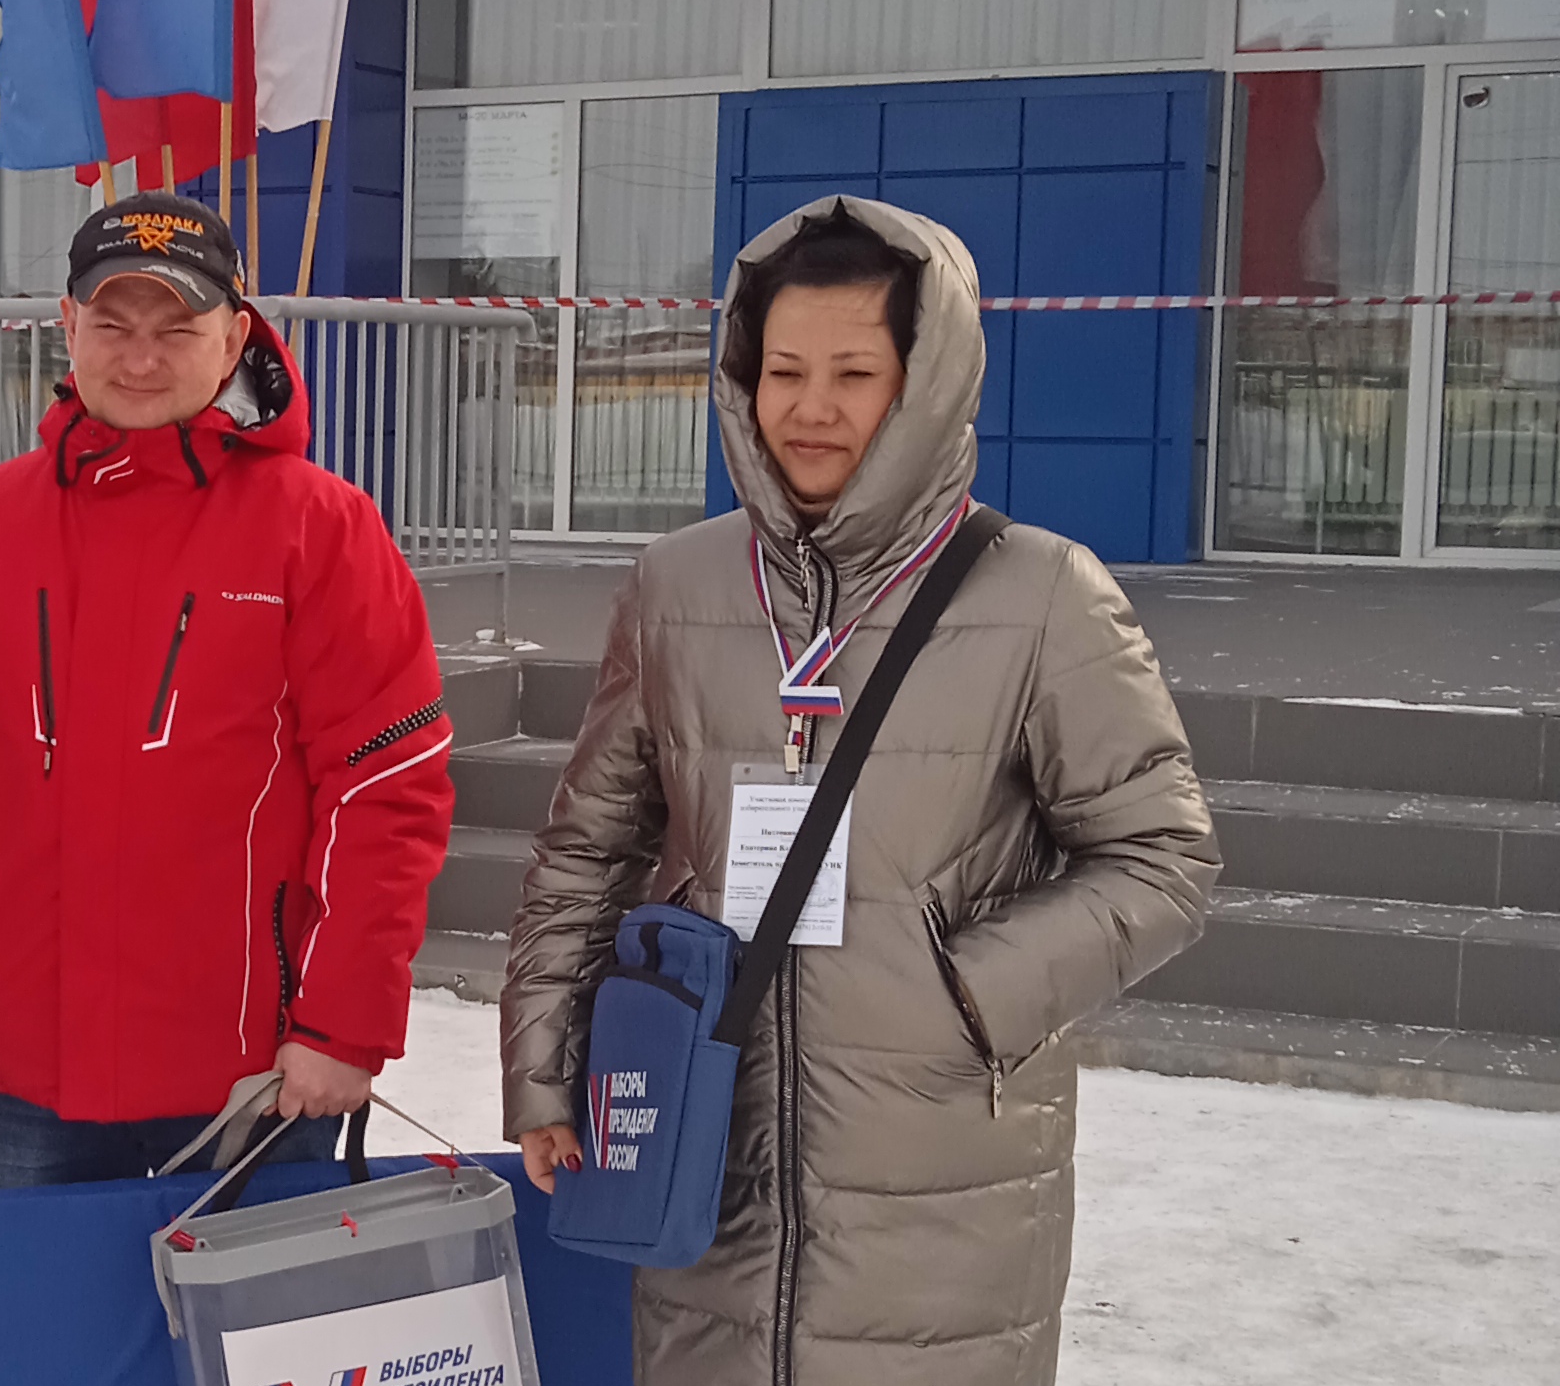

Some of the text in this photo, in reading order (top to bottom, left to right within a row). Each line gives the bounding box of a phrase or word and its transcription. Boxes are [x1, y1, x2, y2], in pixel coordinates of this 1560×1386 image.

[120, 213, 205, 236] KOSADAKA
[96, 238, 139, 252] SMART
[379, 1343, 473, 1383] ВЫБОРЫ
